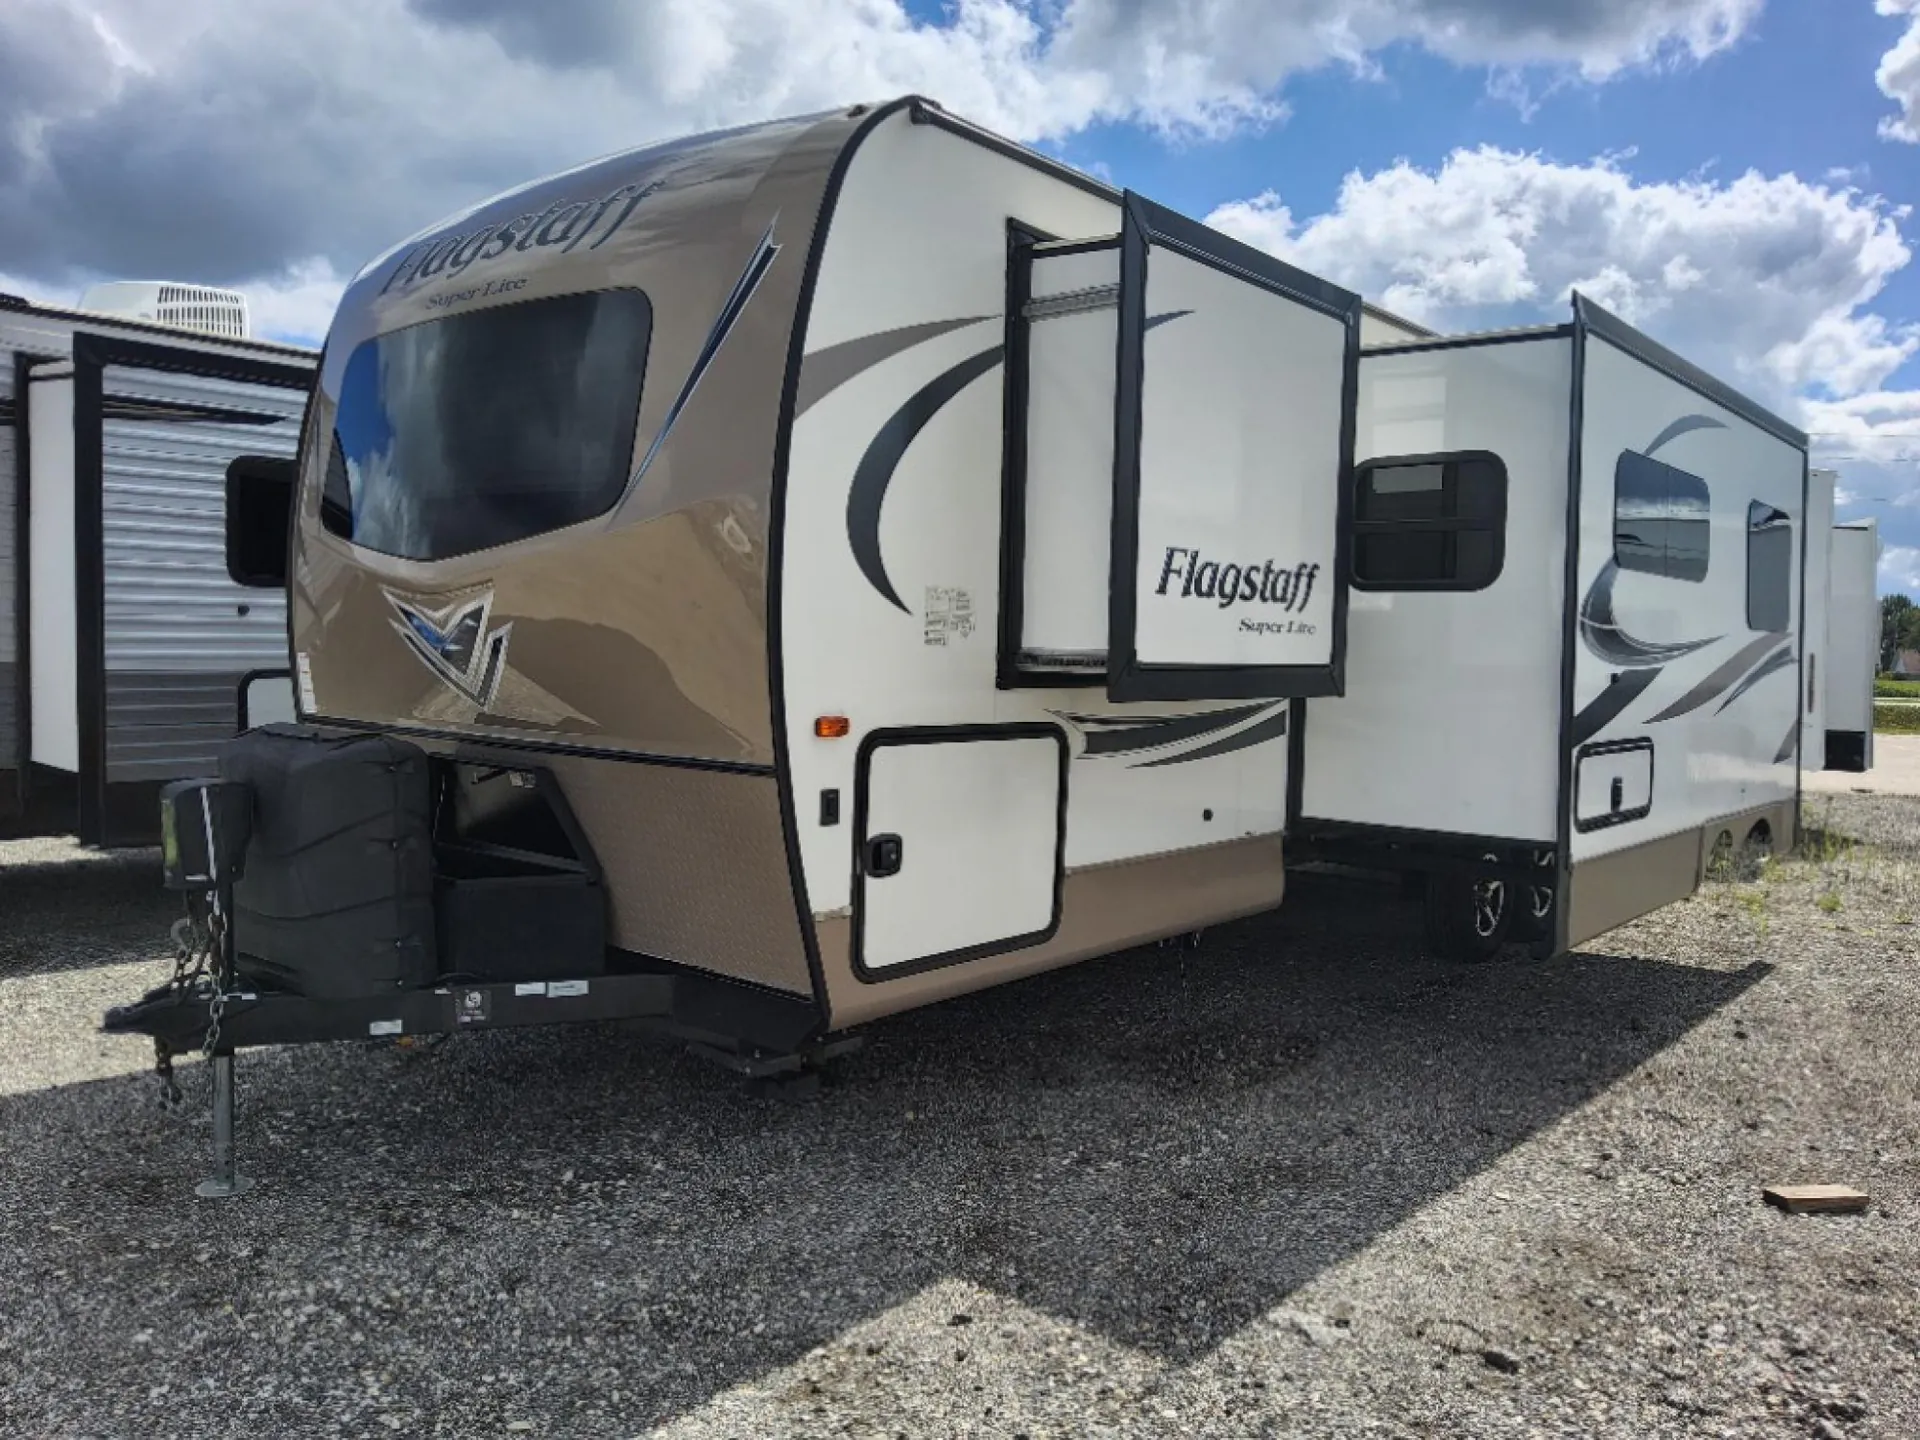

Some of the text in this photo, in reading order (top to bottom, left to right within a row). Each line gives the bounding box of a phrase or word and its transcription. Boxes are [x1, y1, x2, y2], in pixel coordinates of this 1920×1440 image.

[378, 179, 668, 298] Flagstaff
[425, 277, 528, 311] Super Lite
[1155, 546, 1320, 613] Flagstaff
[1239, 618, 1317, 636] Super Lite
